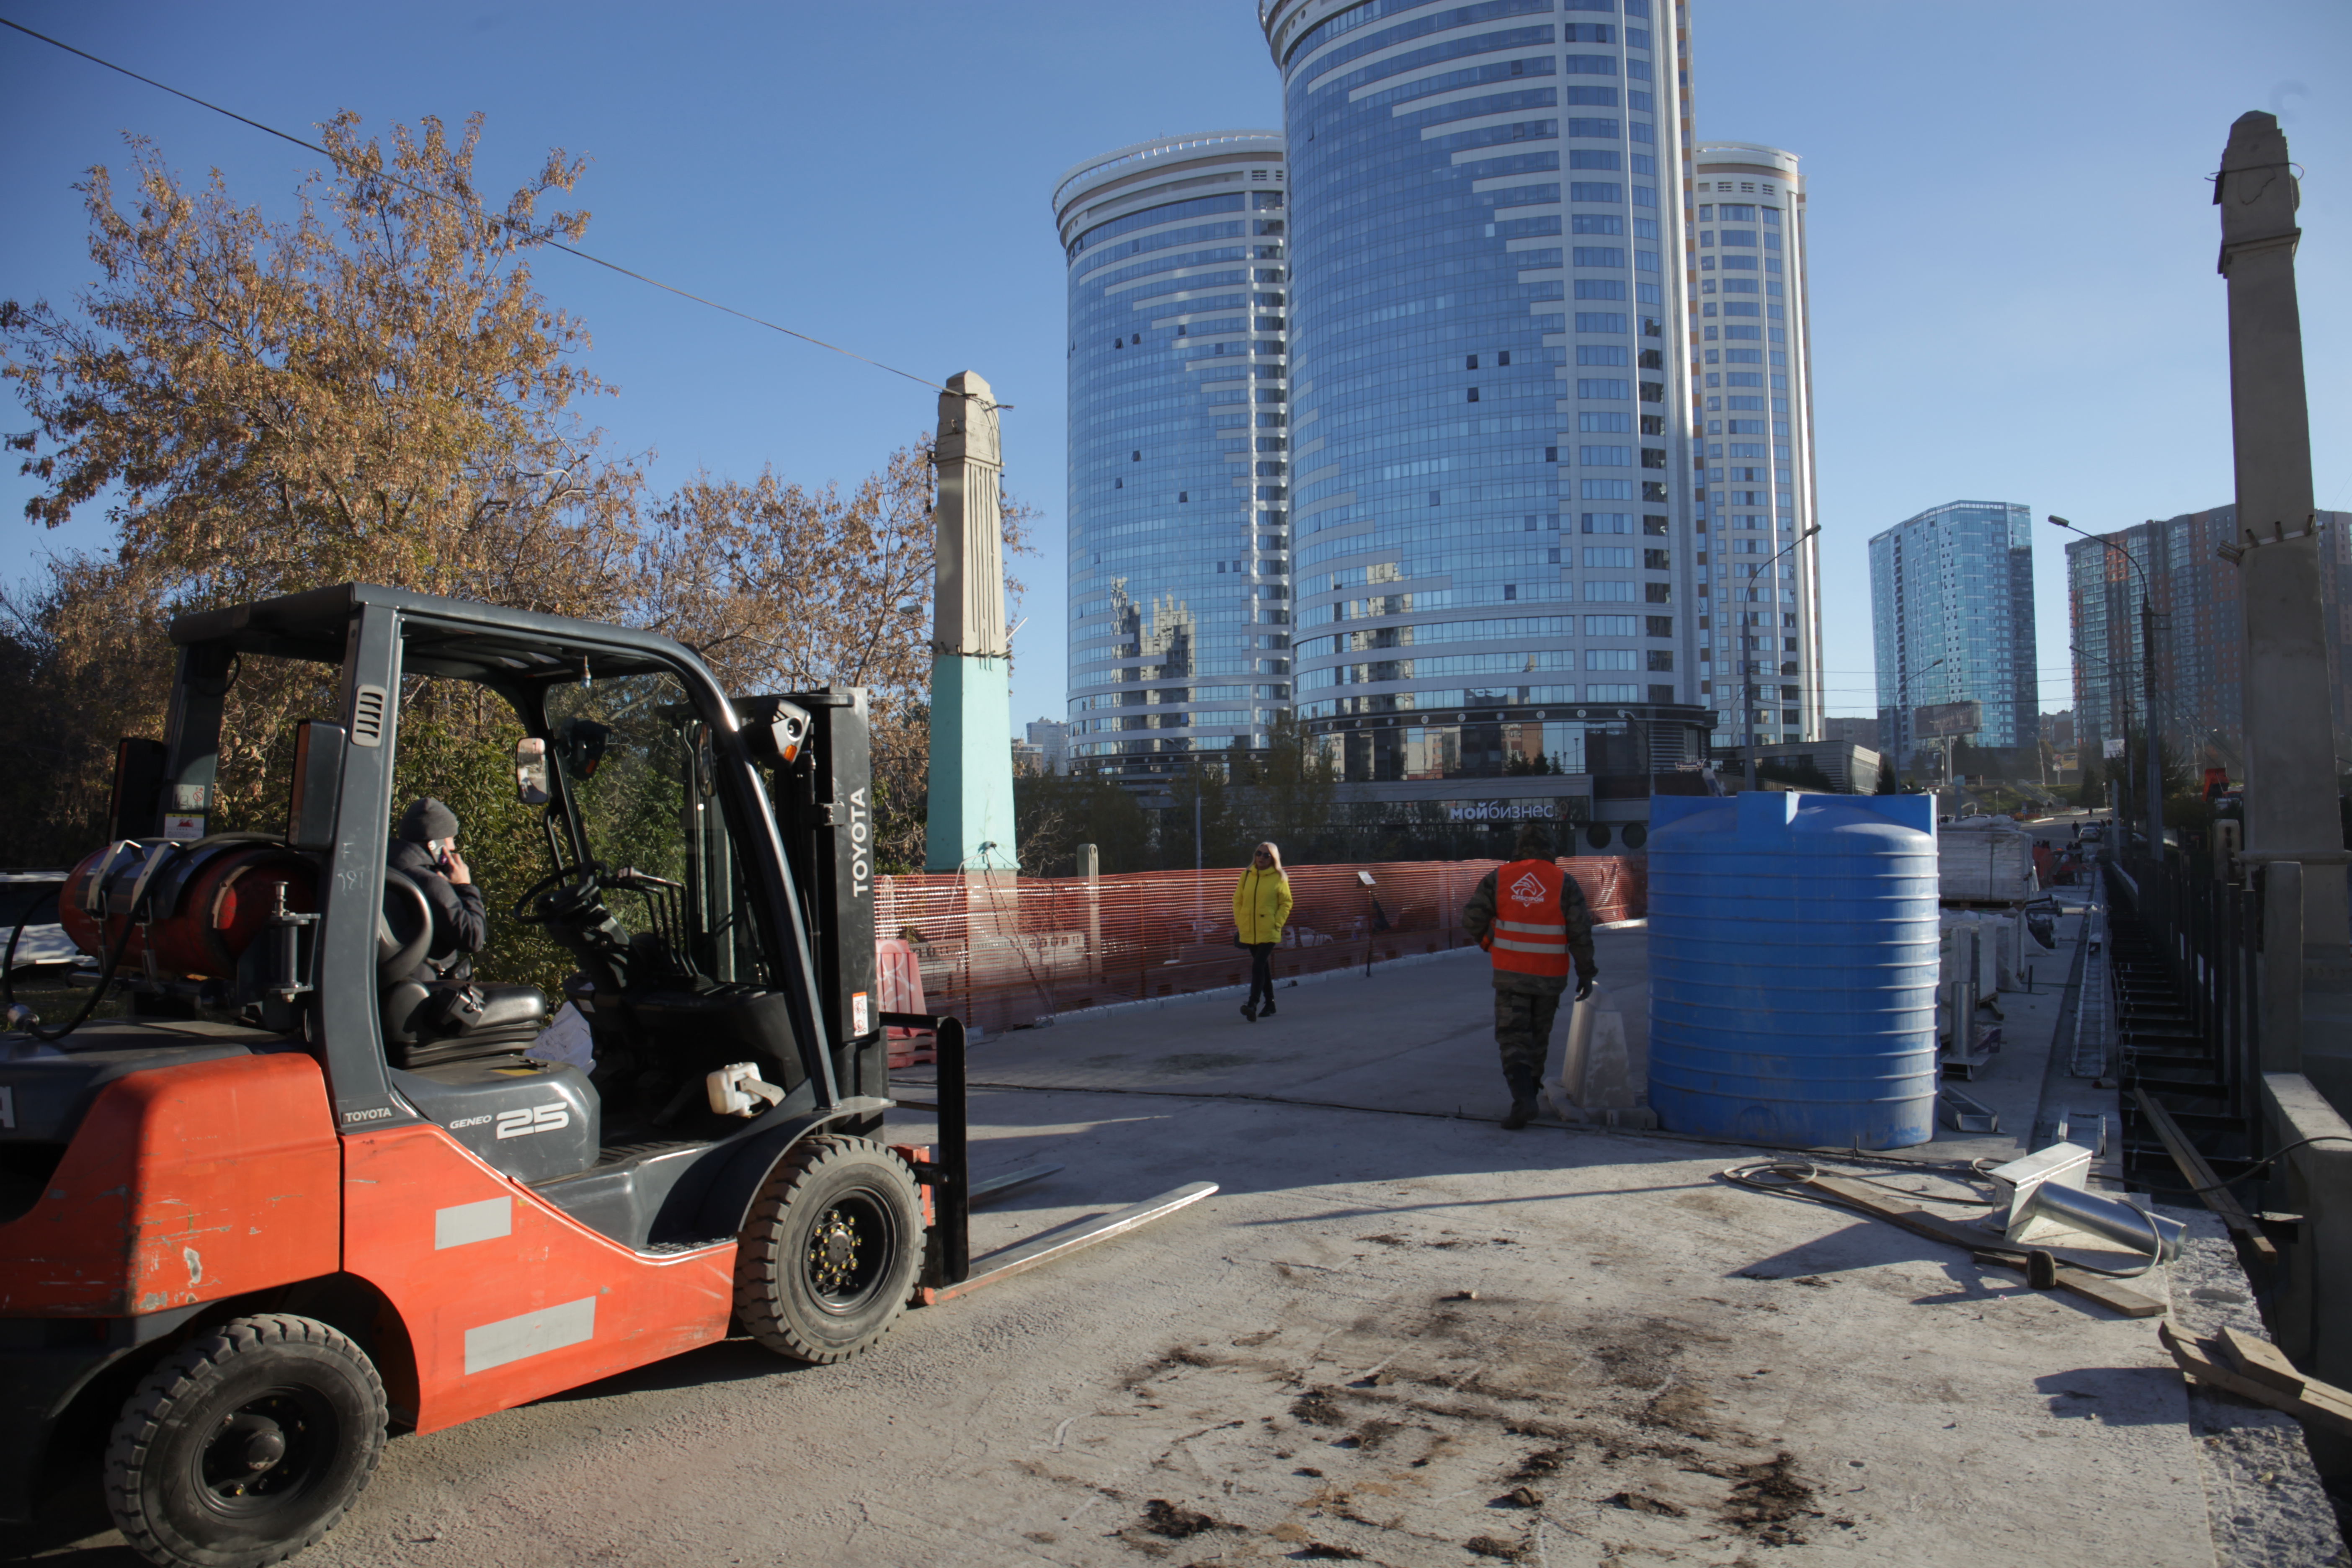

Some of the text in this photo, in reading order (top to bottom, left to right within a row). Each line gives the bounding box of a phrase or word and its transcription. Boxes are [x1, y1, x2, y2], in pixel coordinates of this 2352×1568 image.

[850, 787, 869, 897] TOYOTA
[345, 1107, 392, 1122] TOYOTA
[449, 1101, 570, 1140] GENEO 25
